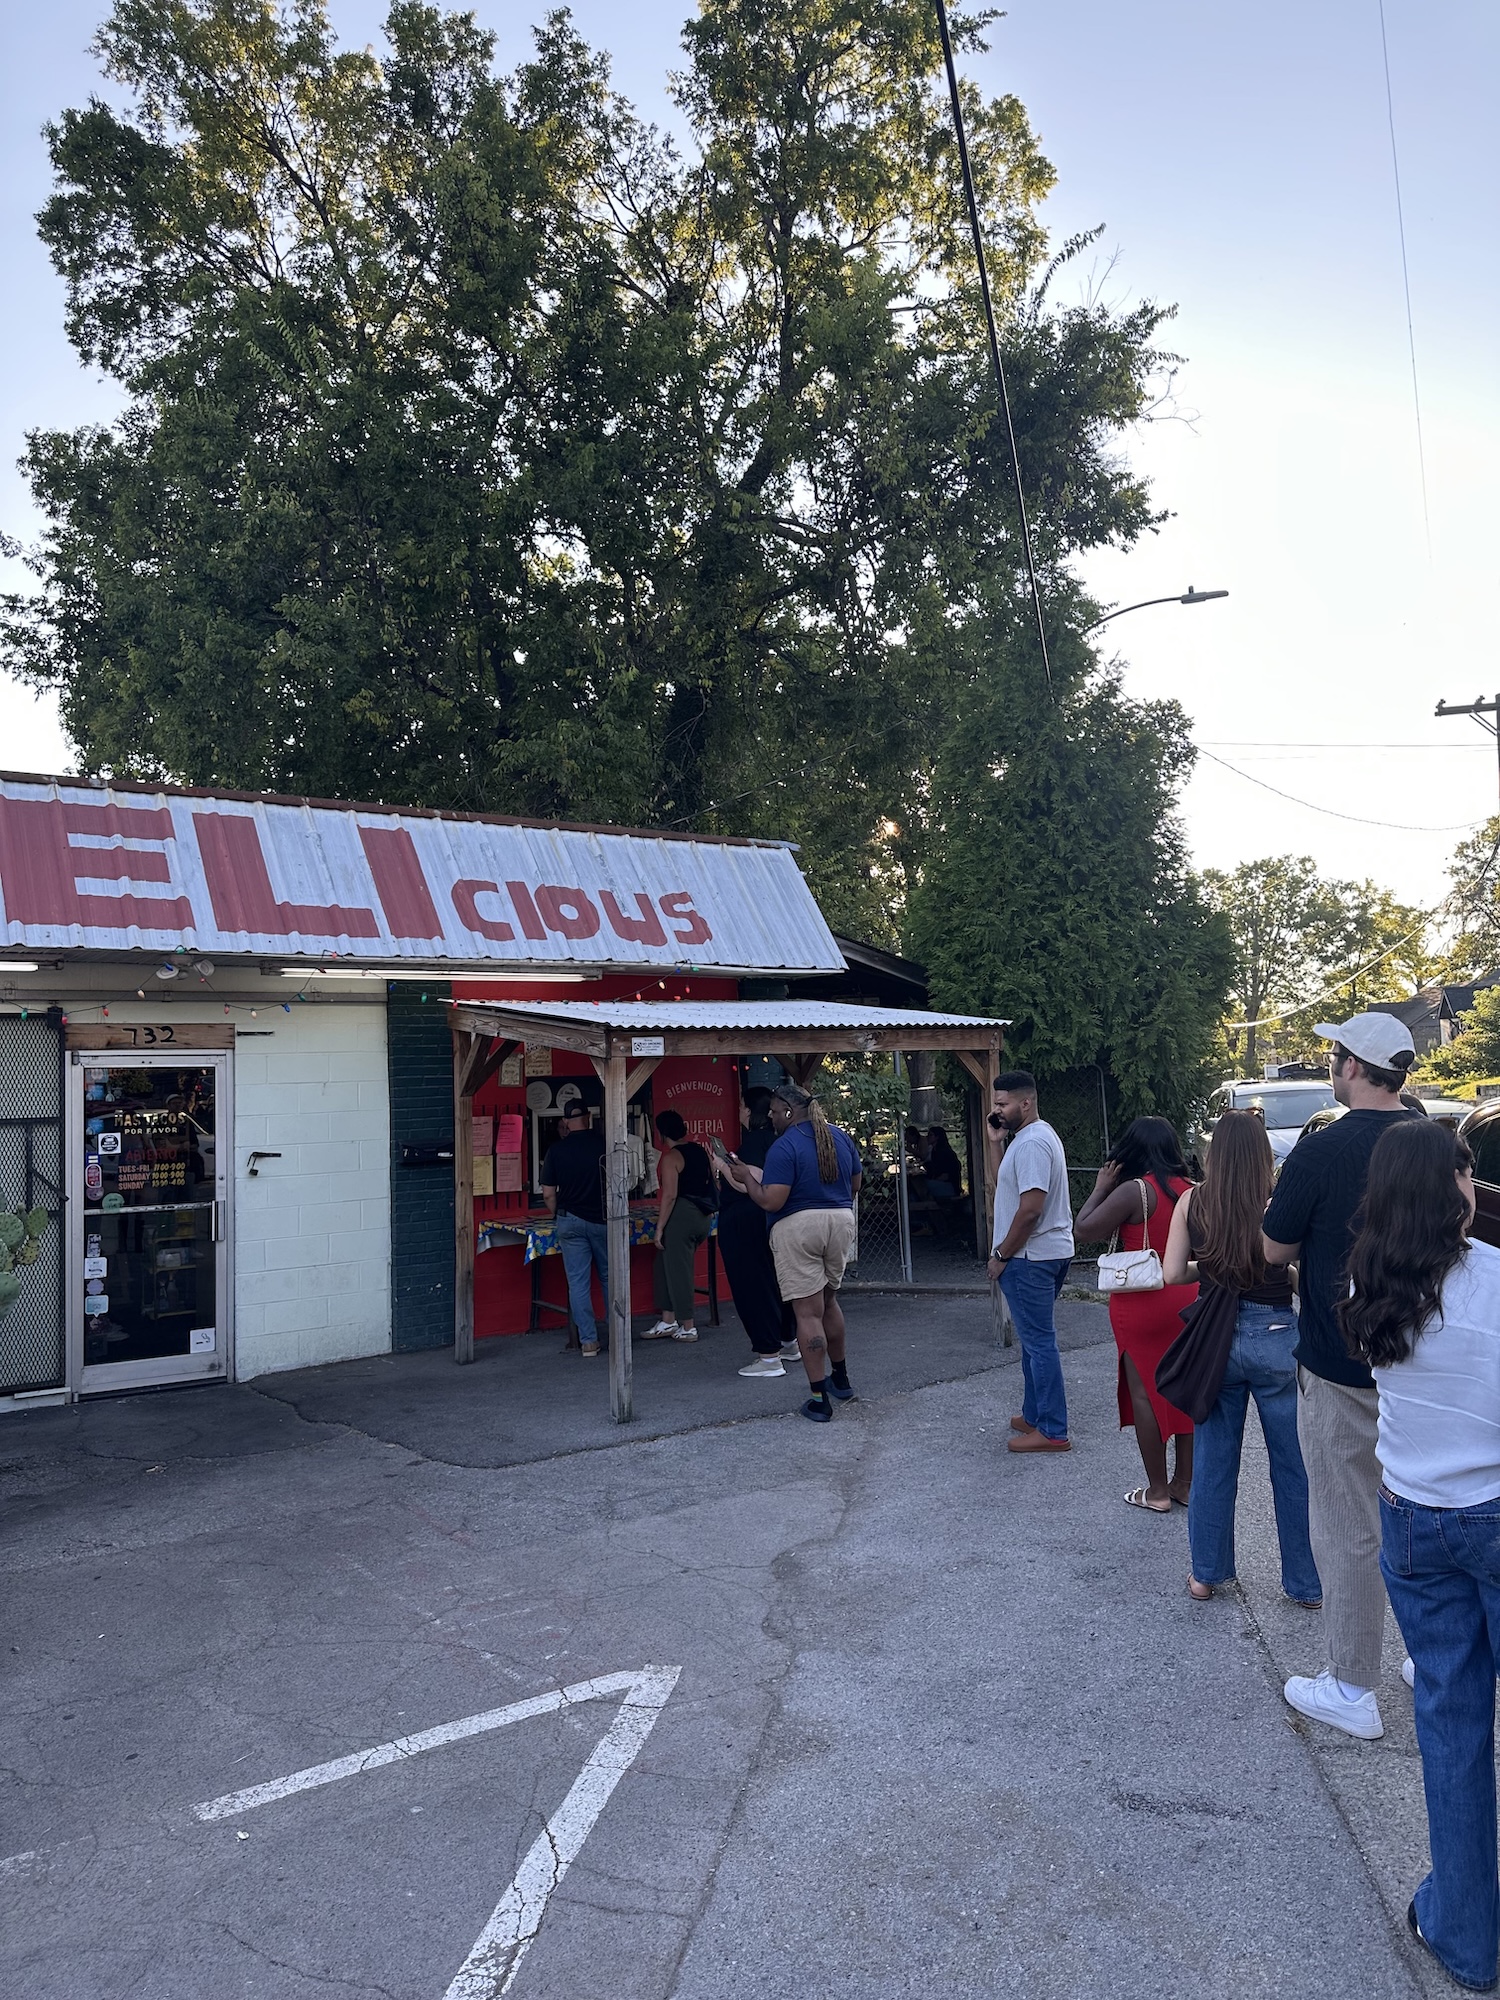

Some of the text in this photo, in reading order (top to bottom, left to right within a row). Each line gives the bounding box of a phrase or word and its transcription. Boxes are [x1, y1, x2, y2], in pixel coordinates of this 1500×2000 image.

[122, 1025, 177, 1047] 732
[666, 1080, 723, 1099] BIENVENIDOS
[683, 1118, 724, 1134] QUERIA
[118, 1172, 151, 1182] SATURDAY
[118, 1181, 145, 1191] SUNDAY
